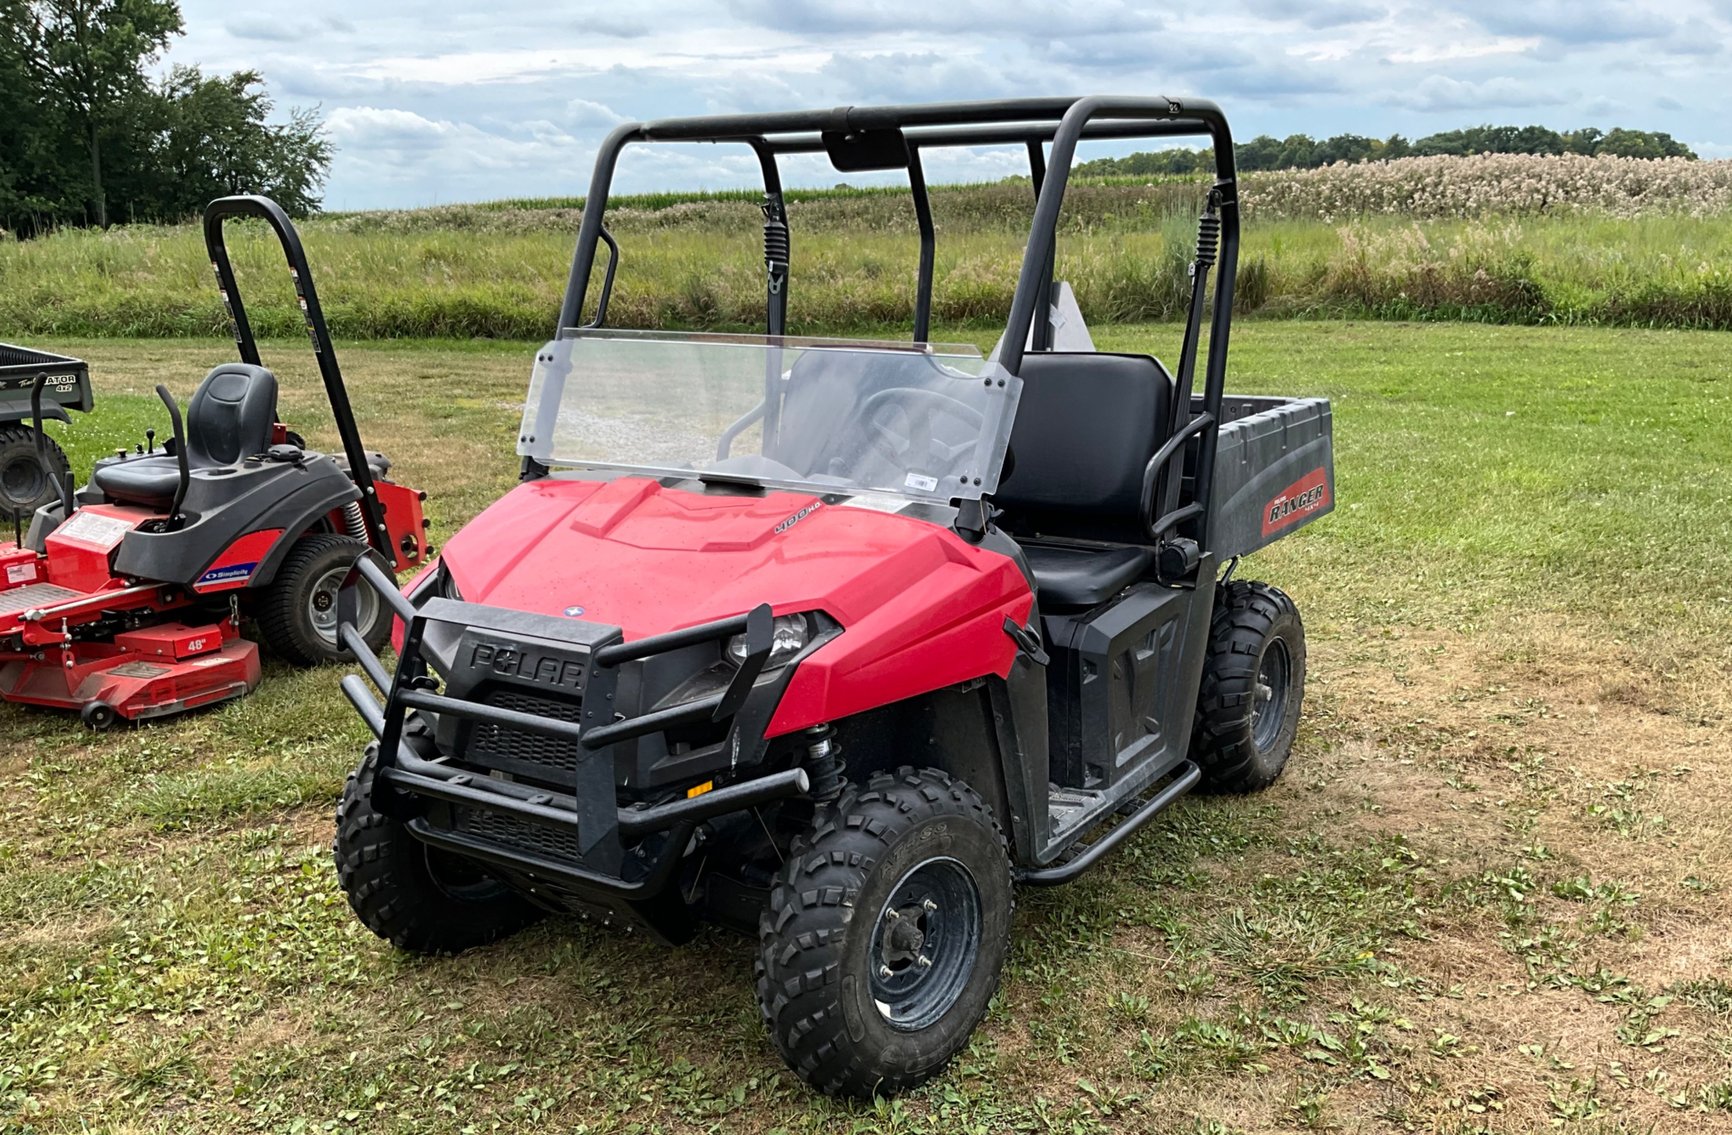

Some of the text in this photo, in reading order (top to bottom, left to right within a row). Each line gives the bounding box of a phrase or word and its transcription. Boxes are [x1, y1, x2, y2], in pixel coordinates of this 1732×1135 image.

[44, 375, 76, 385] ATOR
[1268, 483, 1324, 524] RANGER
[775, 508, 808, 534] 400
[218, 569, 248, 578] Simplicity
[188, 638, 206, 651] 48"
